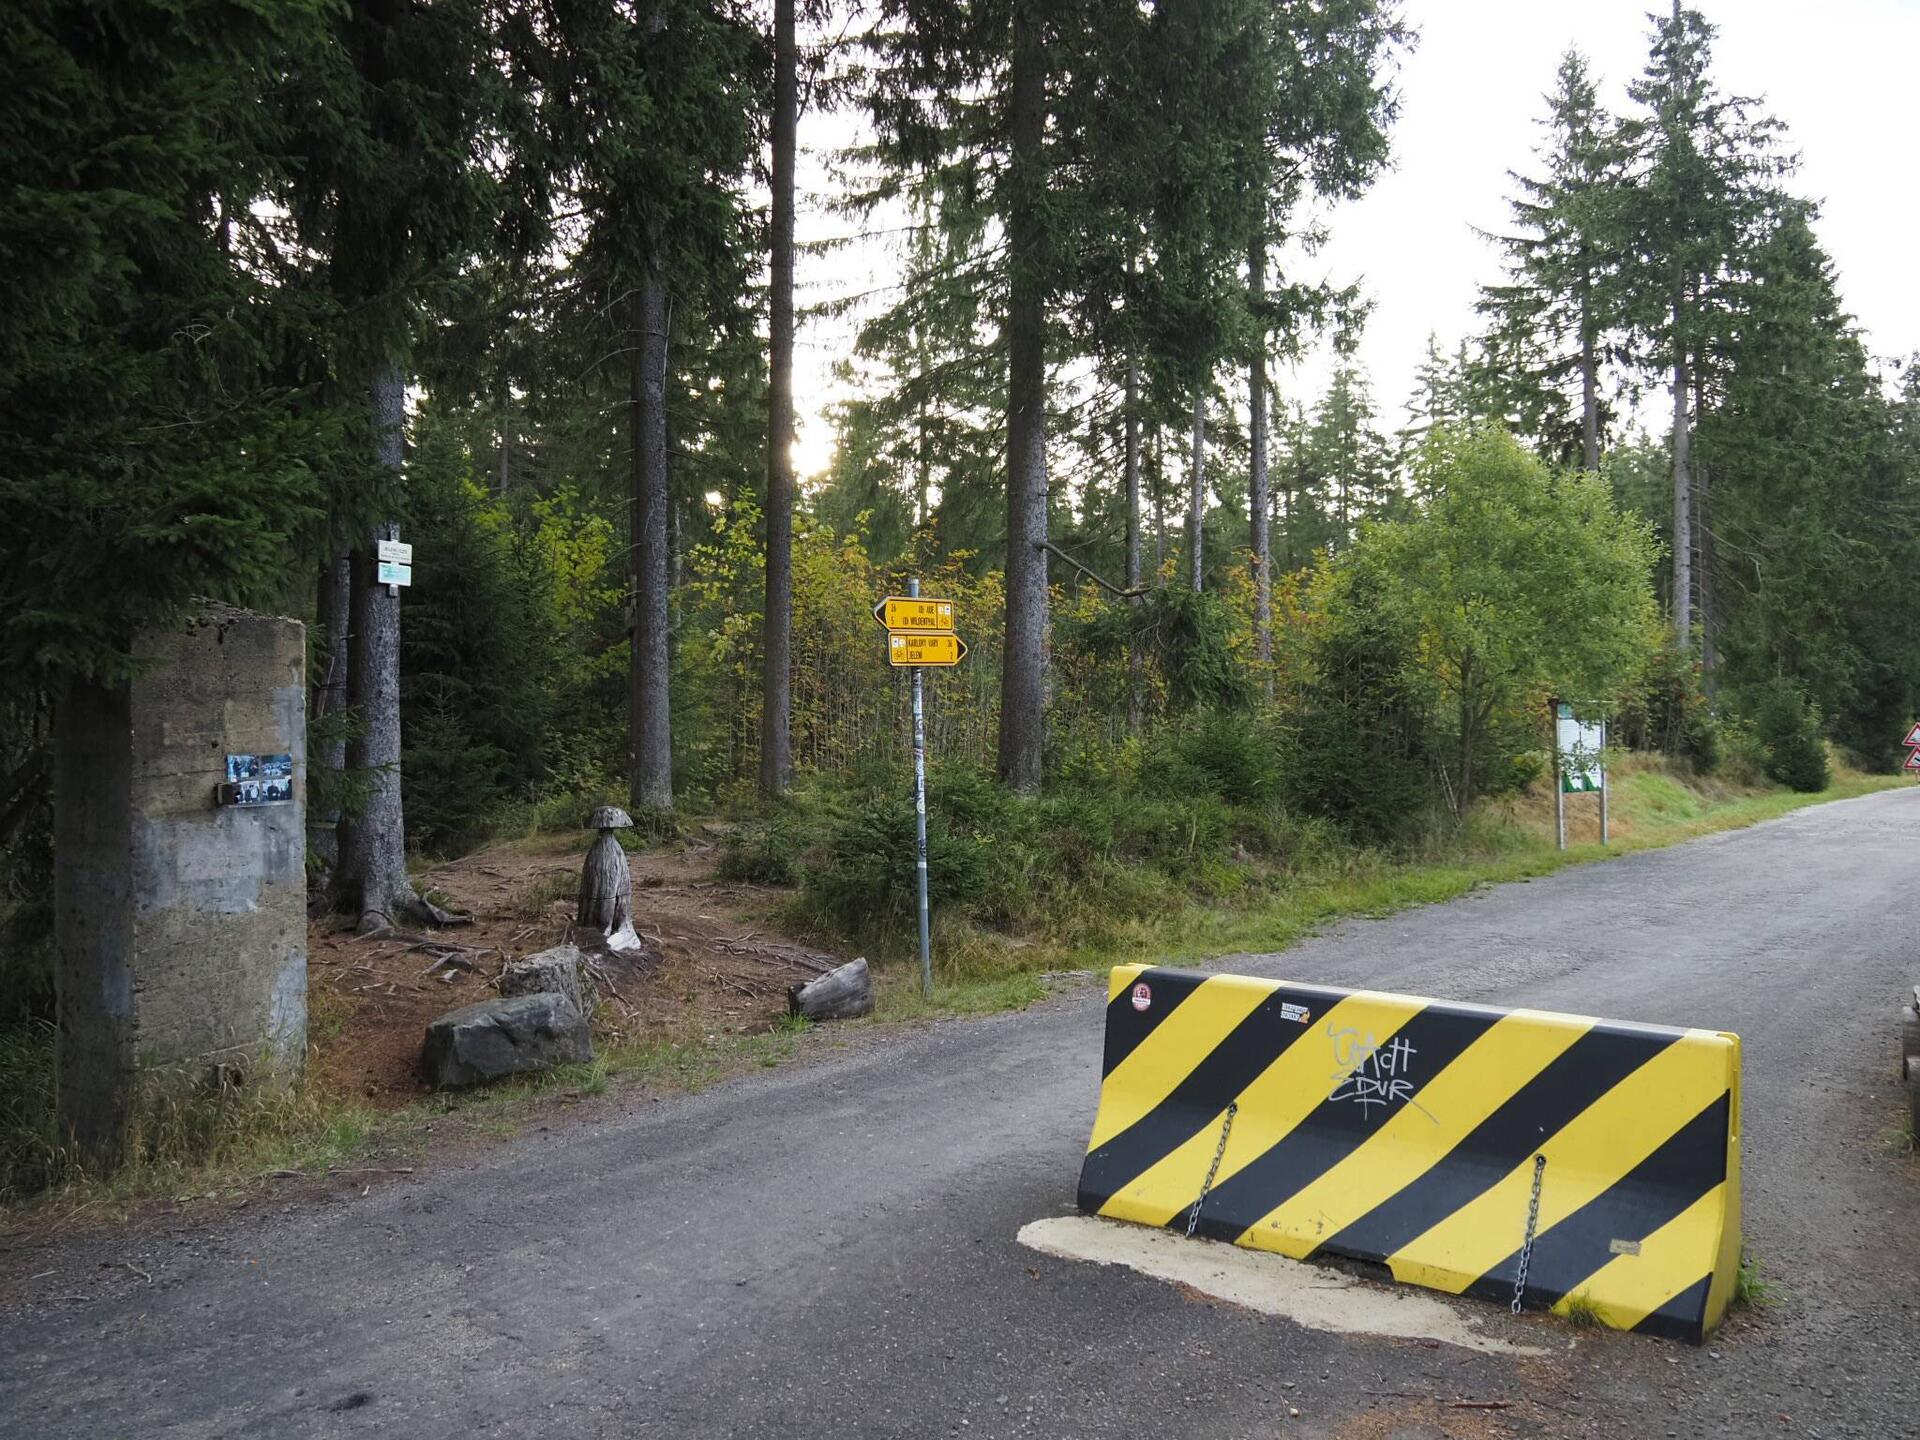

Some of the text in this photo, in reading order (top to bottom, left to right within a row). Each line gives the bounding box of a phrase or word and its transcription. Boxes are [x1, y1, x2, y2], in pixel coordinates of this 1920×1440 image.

[910, 617, 936, 626] WILDENTHAL
[908, 639, 927, 647] KARLOVY
[928, 640, 939, 648] VARY
